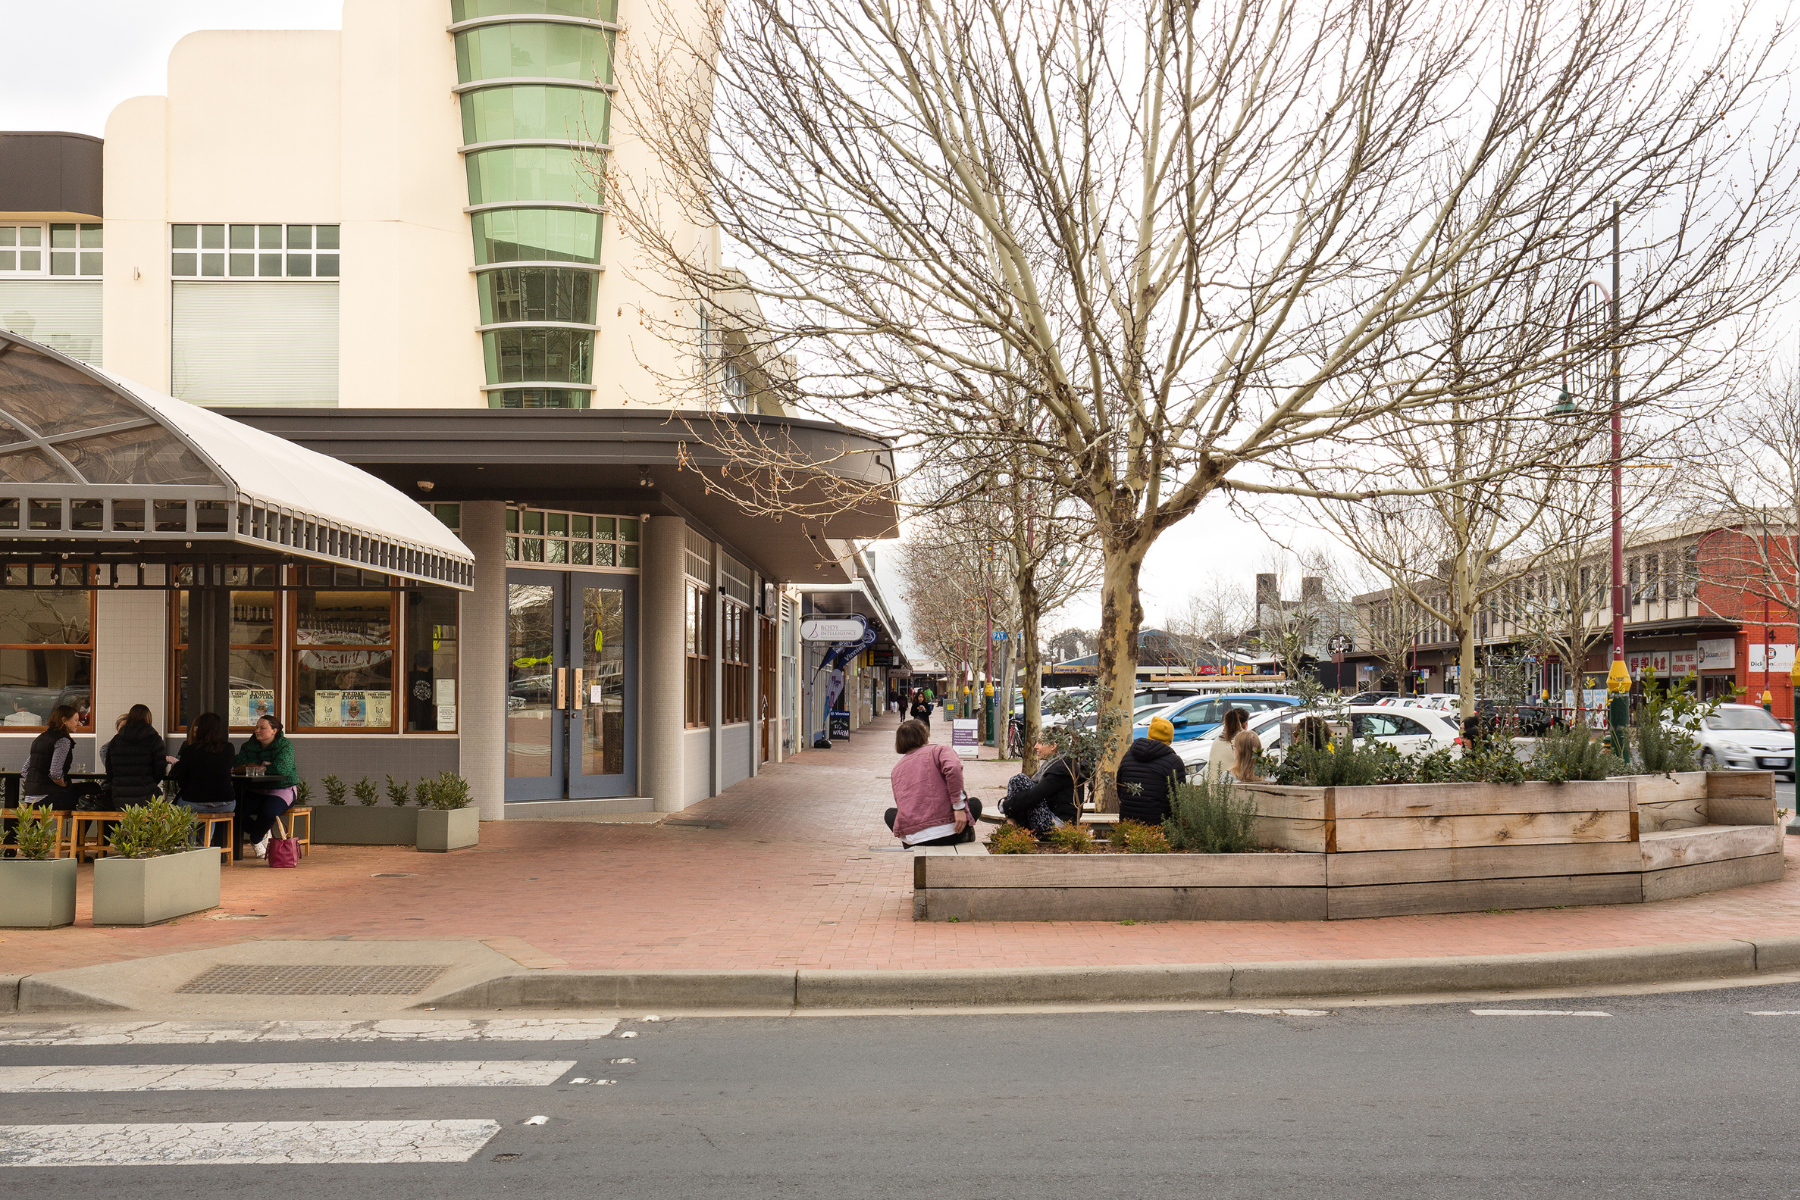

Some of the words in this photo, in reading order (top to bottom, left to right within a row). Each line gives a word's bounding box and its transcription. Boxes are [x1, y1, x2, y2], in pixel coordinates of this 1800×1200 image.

[844, 644, 866, 661] Vinnies
[1685, 654, 1694, 662] KEE
[1672, 664, 1686, 672] ROAST
